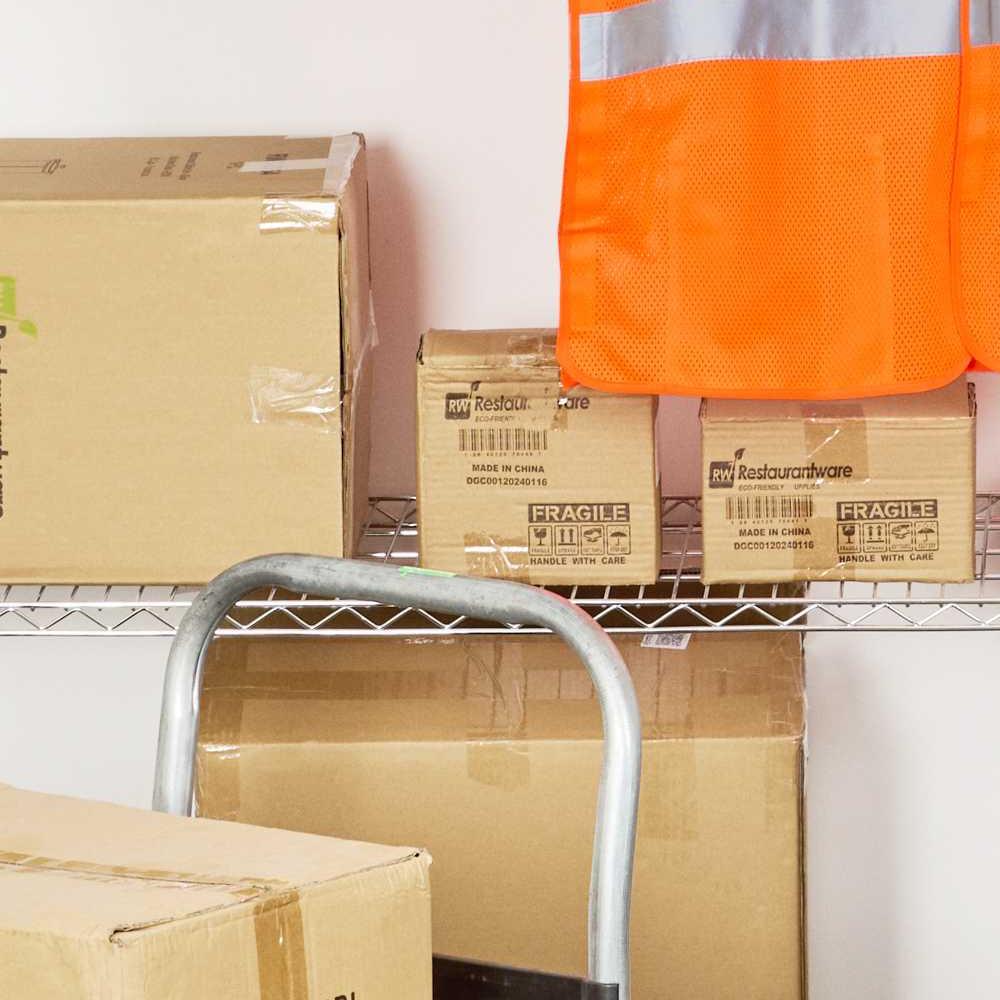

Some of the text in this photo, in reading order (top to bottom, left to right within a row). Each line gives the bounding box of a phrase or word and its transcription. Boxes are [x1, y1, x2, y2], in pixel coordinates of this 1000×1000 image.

[449, 395, 590, 415] RW Restaurare
[472, 464, 544, 473] MADE IN CHINA
[712, 463, 853, 482] RW Restaurantware
[532, 504, 627, 521] FRAGILE
[840, 501, 935, 519] FRAGILE
[739, 528, 765, 537] MADE
[781, 527, 811, 536] CHINA
[530, 556, 626, 565] HANDLE WITH CARE
[838, 552, 934, 563] HANDLE WITH CARE
